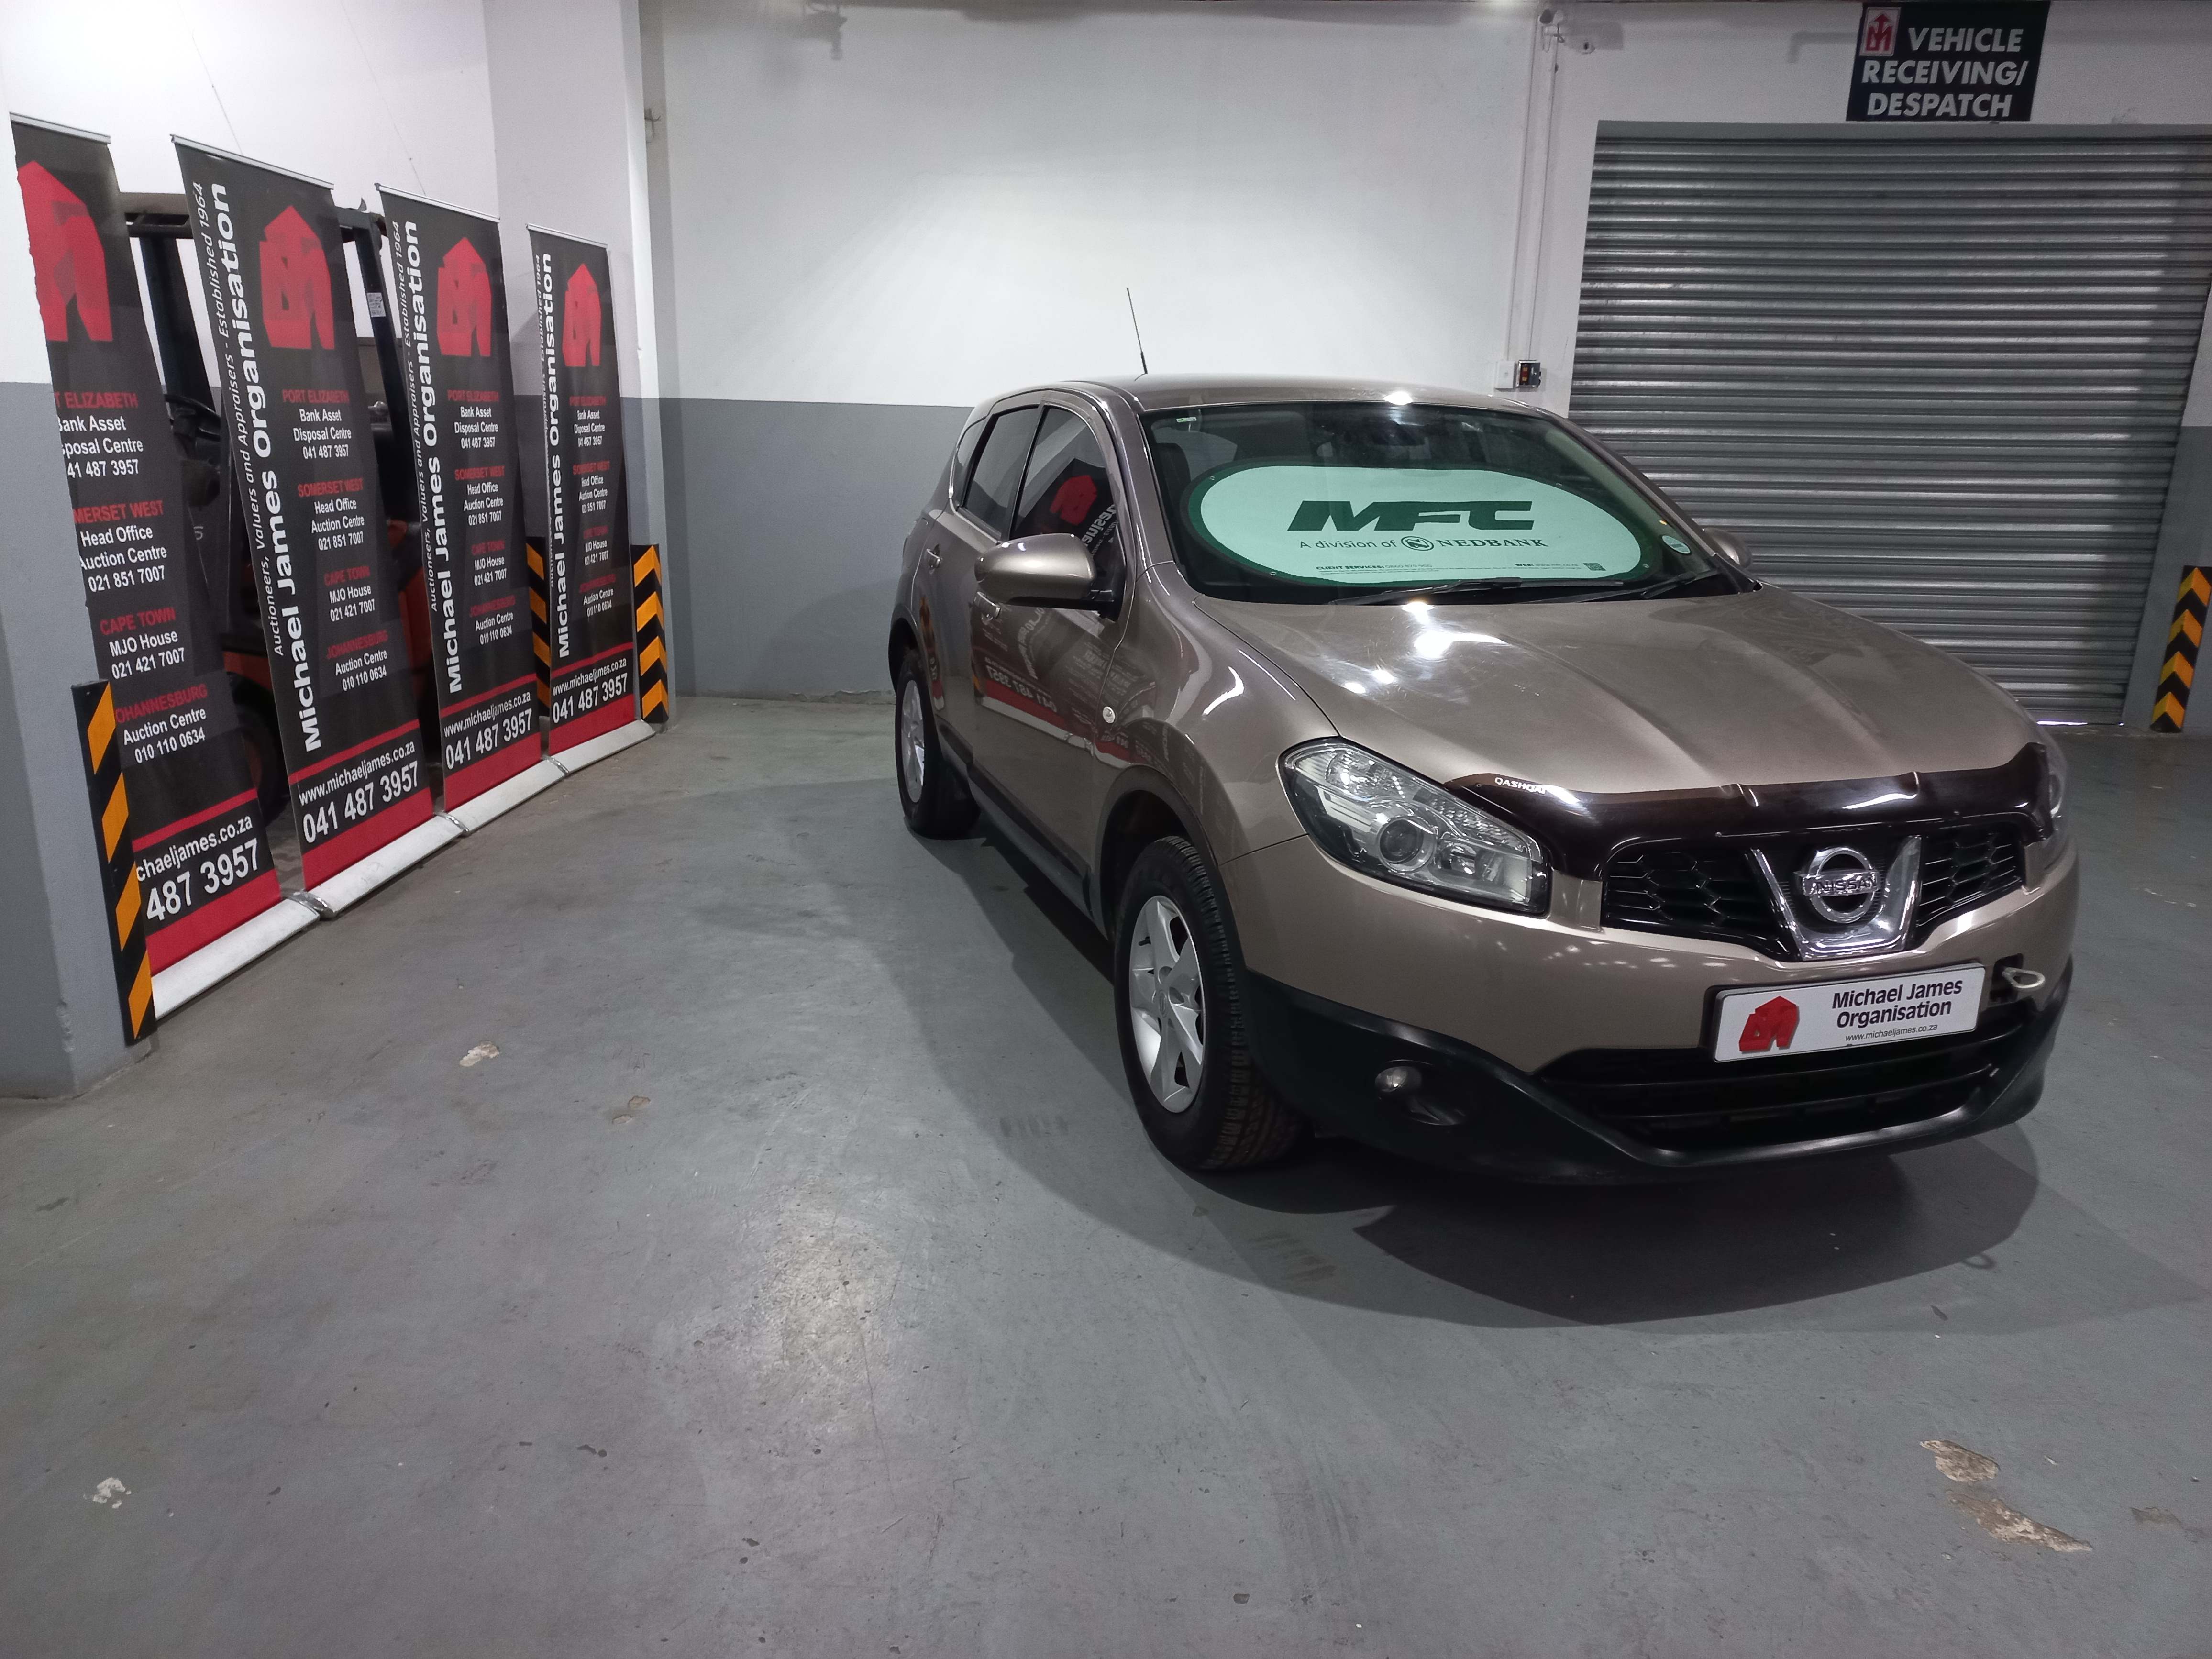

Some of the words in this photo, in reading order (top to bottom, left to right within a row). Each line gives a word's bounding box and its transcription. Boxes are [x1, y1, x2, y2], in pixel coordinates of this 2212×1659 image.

[1908, 28, 2024, 52] VEHICLE
[1862, 60, 2029, 85] RECEIVING/
[1867, 92, 2012, 117] DESPATCH
[192, 181, 211, 229] 1964
[392, 221, 402, 259] 1964
[205, 233, 230, 339] Established
[397, 261, 412, 348] Established
[211, 182, 272, 459] organisation
[405, 220, 438, 447] organisation
[543, 254, 559, 446] organisation
[65, 392, 138, 408] ELIZABETH
[225, 354, 249, 448] Appraisers
[282, 389, 306, 402] PORT
[308, 390, 350, 404] ELIZABETH
[409, 361, 421, 439] Appraisers
[89, 415, 127, 431] Asset
[299, 409, 321, 422] Bank
[322, 409, 342, 421] Asset
[460, 406, 475, 418] Bank
[475, 407, 492, 418] Asset
[587, 410, 600, 419] Asset
[293, 427, 329, 443] Disposal
[330, 426, 351, 439] Centre
[454, 422, 479, 435] Disposal
[480, 421, 498, 433] Centre
[591, 423, 605, 432] Centre
[102, 437, 144, 453] Centre
[302, 445, 317, 459] 041
[318, 445, 332, 458] 487
[334, 444, 349, 457] 3957
[461, 437, 470, 449] 041
[472, 437, 481, 448] 487
[483, 437, 495, 447] 3957
[67, 462, 82, 478] 41
[86, 461, 106, 477] 487
[111, 459, 139, 475] 3957
[243, 450, 255, 483] and
[298, 480, 343, 498] SOMERSET
[467, 483, 480, 495] Head
[481, 482, 498, 493] Office
[590, 475, 604, 485] Office
[464, 499, 485, 511] Auction
[486, 497, 503, 508] Centre
[552, 454, 564, 545] James
[594, 488, 608, 498] Centre
[596, 500, 606, 511] 7007
[73, 504, 126, 524] MERSET
[129, 500, 164, 516] WEST
[314, 501, 334, 515] Head
[335, 498, 357, 512] Office
[428, 456, 449, 562] James
[468, 515, 477, 526] 021
[478, 513, 488, 524] 851
[489, 510, 502, 522] 7007
[1287, 500, 1534, 531] MFC
[249, 489, 266, 551] valuers
[311, 518, 341, 534] Auction
[342, 515, 365, 528] Centre
[80, 529, 114, 547] Head
[116, 525, 153, 542] Office
[261, 470, 296, 596] James
[318, 535, 330, 551] 021
[333, 533, 347, 548] 851
[349, 531, 364, 544] 7007
[593, 540, 607, 550] House
[1316, 539, 1381, 549] division
[1382, 539, 1396, 548] of
[1436, 539, 1549, 547] NEDBANK
[127, 546, 167, 562] Centre
[475, 558, 486, 571] MJO
[487, 556, 505, 568] House
[88, 575, 111, 592] 021
[113, 569, 135, 588] 851
[138, 565, 165, 584] 7007
[474, 575, 483, 586] 021
[484, 572, 494, 583] 421
[495, 568, 507, 580] 7007
[329, 589, 346, 604] MJO
[347, 586, 371, 600] House
[555, 552, 569, 658] Michael
[599, 587, 613, 599] Centre
[261, 556, 284, 657] Auctioneers,
[330, 608, 343, 622] 021
[344, 604, 357, 618] 421
[359, 599, 375, 613] 7007
[593, 603, 601, 614] 110
[602, 599, 612, 611] 0634
[100, 615, 136, 635] CAPE
[137, 607, 177, 626] TOWN
[437, 570, 463, 694] Michael
[475, 618, 495, 631] Auction
[496, 611, 513, 625] Centre
[109, 638, 137, 657] MJO
[139, 631, 178, 650] House
[480, 633, 488, 645] 010
[489, 630, 499, 642] 110
[500, 625, 512, 638] 0634
[111, 661, 132, 679] 021
[135, 654, 156, 673] 421
[158, 648, 185, 667] 7007
[335, 659, 363, 676] Auction
[364, 649, 387, 665] Centre
[282, 606, 322, 752] Michael
[342, 678, 354, 692] 010
[355, 671, 368, 686] 110
[369, 665, 387, 681] 0634
[553, 658, 627, 696] www.michaeljames.co.za
[115, 684, 208, 724] OHANNESBURG
[553, 695, 574, 723] 041
[578, 685, 598, 711] 487
[602, 673, 628, 701] 3957
[123, 720, 168, 745] Auction
[169, 708, 207, 730] Centre
[444, 692, 531, 738] www.michaeljames.co.za
[134, 744, 154, 764] 010
[156, 735, 177, 755] 110
[179, 727, 206, 749] 0634
[446, 736, 471, 769] 041
[476, 723, 498, 754] 487
[503, 708, 532, 741] 3957
[299, 741, 415, 806] www.michaeljames.co.za
[303, 801, 338, 843] 041
[344, 782, 374, 820] 487
[380, 761, 418, 803] 3957
[136, 815, 253, 882] chaeljames.co.za
[146, 871, 191, 921] 487
[200, 838, 258, 894] 3957
[1832, 985, 1902, 1009] Michael
[1906, 980, 1963, 1001] James
[1836, 1000, 1952, 1029] Organisation
[1845, 1024, 1938, 1042] www.michaeljames.co.za
